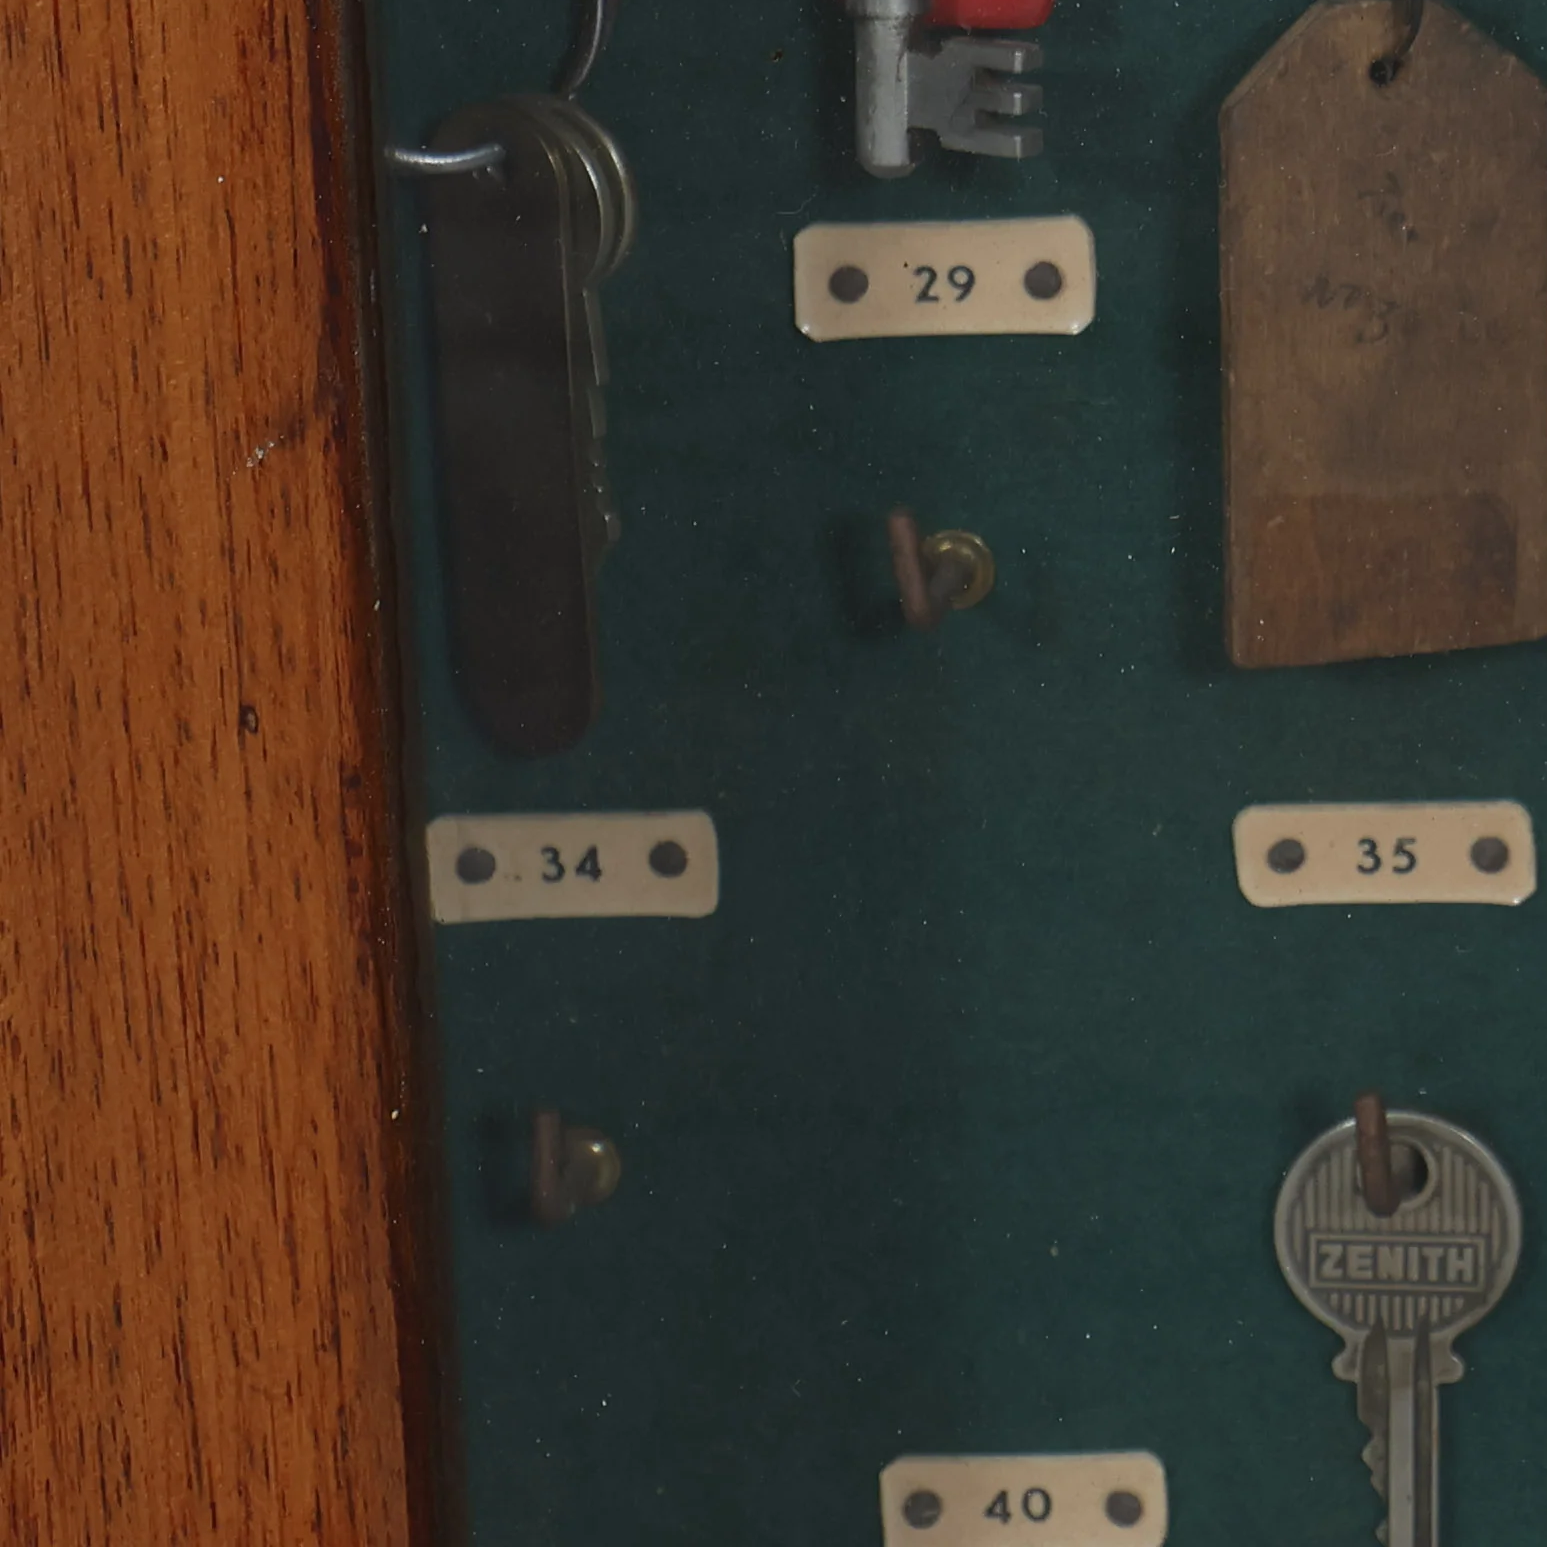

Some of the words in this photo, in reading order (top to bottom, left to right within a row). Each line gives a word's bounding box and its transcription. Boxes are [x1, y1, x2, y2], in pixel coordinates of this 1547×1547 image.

[913, 264, 977, 304] 29
[540, 844, 603, 884] 34
[1356, 836, 1418, 875] 35
[1316, 1241, 1476, 1285] ZENITH
[983, 1486, 1053, 1525] 40
